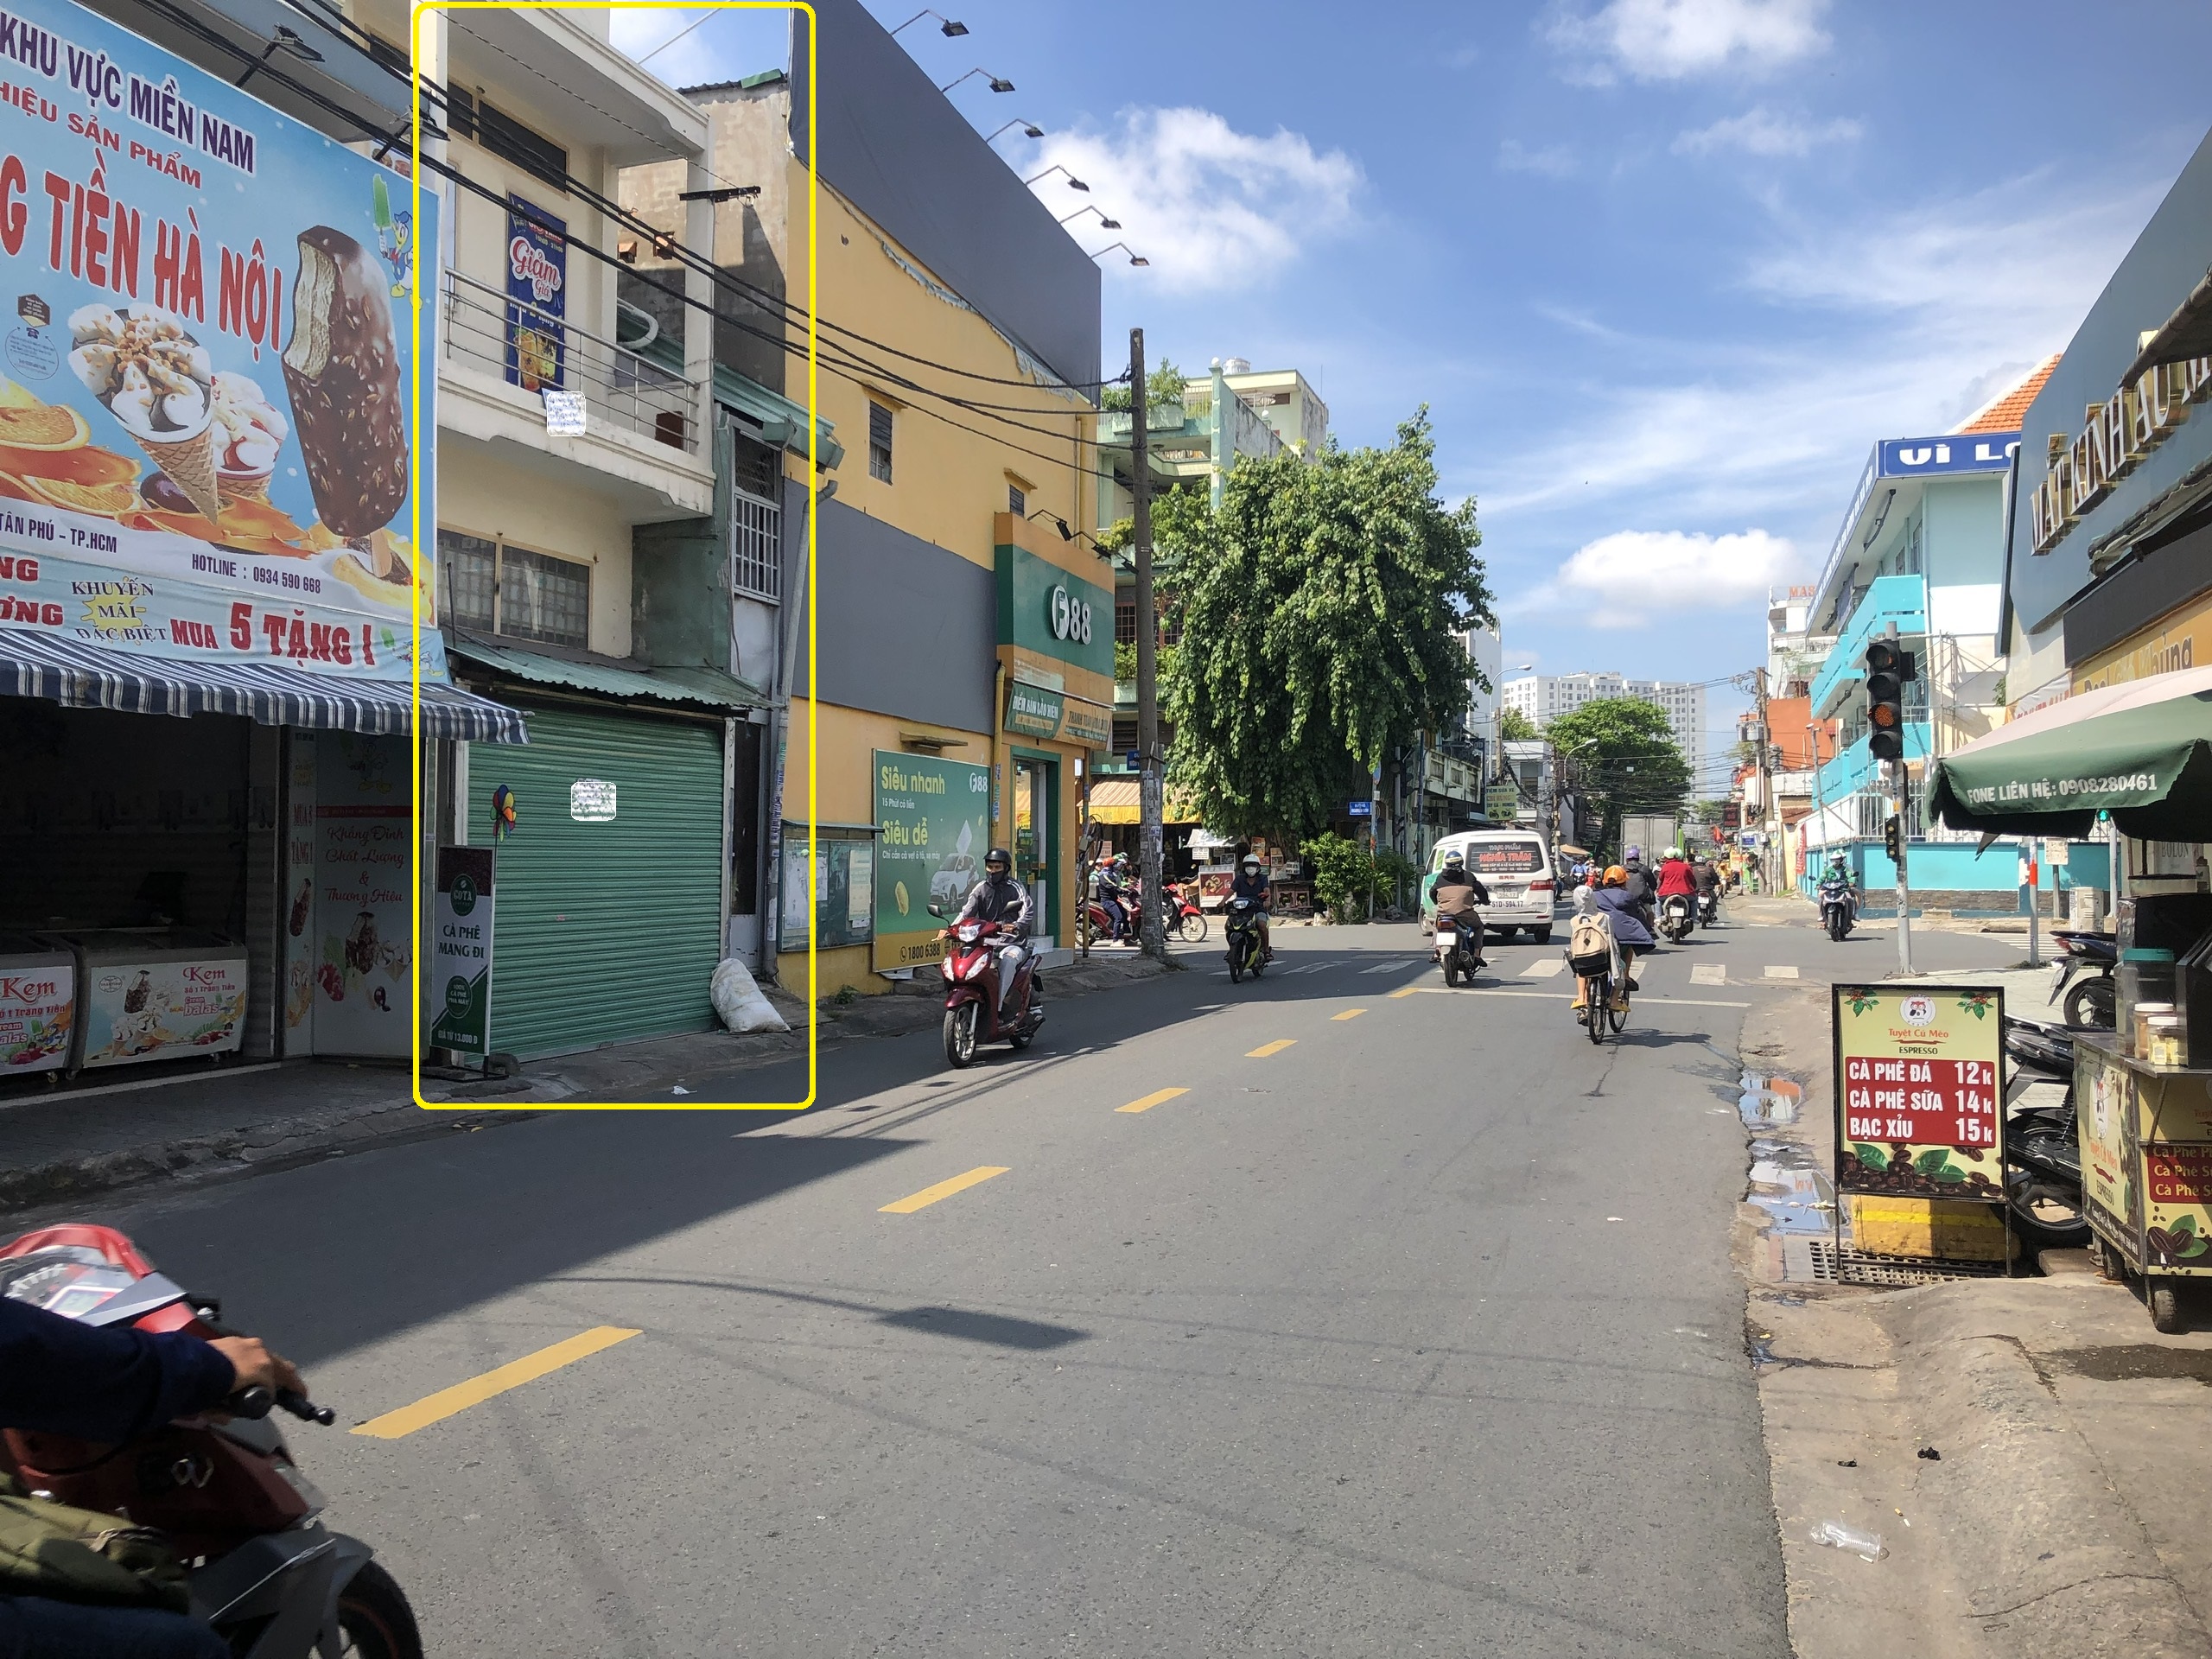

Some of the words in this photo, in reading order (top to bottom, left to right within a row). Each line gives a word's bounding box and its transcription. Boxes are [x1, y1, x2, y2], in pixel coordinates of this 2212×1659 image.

[0, 11, 57, 76] KHU
[67, 44, 121, 108] VỰC
[130, 74, 193, 144] MIỀN
[203, 114, 253, 173] NAM
[67, 114, 120, 152] SẢN
[130, 150, 201, 189] PHẨM
[45, 147, 140, 299] TIỀN
[154, 206, 204, 324] HÀ
[219, 238, 283, 362] NỘI
[512, 239, 558, 286] Giảm
[535, 280, 551, 298] Giá
[2069, 387, 2126, 516] KÍNH
[29, 519, 54, 541] PHÚ
[70, 528, 118, 554] TP.HCM
[192, 554, 236, 578] HOTLINE
[253, 567, 278, 585] 0934
[282, 572, 300, 589] 590
[303, 578, 321, 594] 668
[72, 577, 154, 596] KHUYẾN
[97, 602, 137, 619] MÃI
[75, 624, 120, 643] ĐẶC
[123, 624, 167, 643] BIỆT
[170, 619, 219, 650] MUA
[231, 602, 252, 651] 5
[263, 609, 353, 668] TẶNG
[881, 766, 907, 791] Siêu
[911, 771, 945, 794] nhanh
[1967, 787, 1995, 804] FONE
[1999, 781, 2028, 802] LIÊN
[2059, 774, 2157, 797] 0908280461
[881, 798, 888, 807] 15
[882, 819, 909, 845] Siêu
[912, 817, 928, 846] dễ
[443, 922, 456, 937] CÀ
[459, 925, 480, 940] PHÊ
[438, 942, 469, 957] MANG
[472, 947, 484, 959] ĐI
[908, 944, 924, 960] 1800
[925, 943, 941, 958] 6388
[182, 967, 226, 985] Kem
[0, 976, 55, 1003] Kem
[1888, 1028, 1910, 1039] Tuyệt
[1898, 1046, 1938, 1055] ESPRESSO
[1849, 1059, 1870, 1081] CÀ
[1874, 1060, 1905, 1082] PHÊ
[1910, 1062, 1932, 1083] ĐÁ
[1849, 1087, 1871, 1109] CÀ
[1875, 1089, 1905, 1109] PHÊ
[1910, 1090, 1943, 1111] SỮA
[1850, 1117, 1881, 1141] BẠC
[1885, 1114, 1913, 1138] XỈU
[2154, 1165, 2170, 1176] Cà
[2174, 1165, 2197, 1176] Phê
[2155, 1184, 2171, 1195] Cà
[2176, 1184, 2199, 1196] Phê
